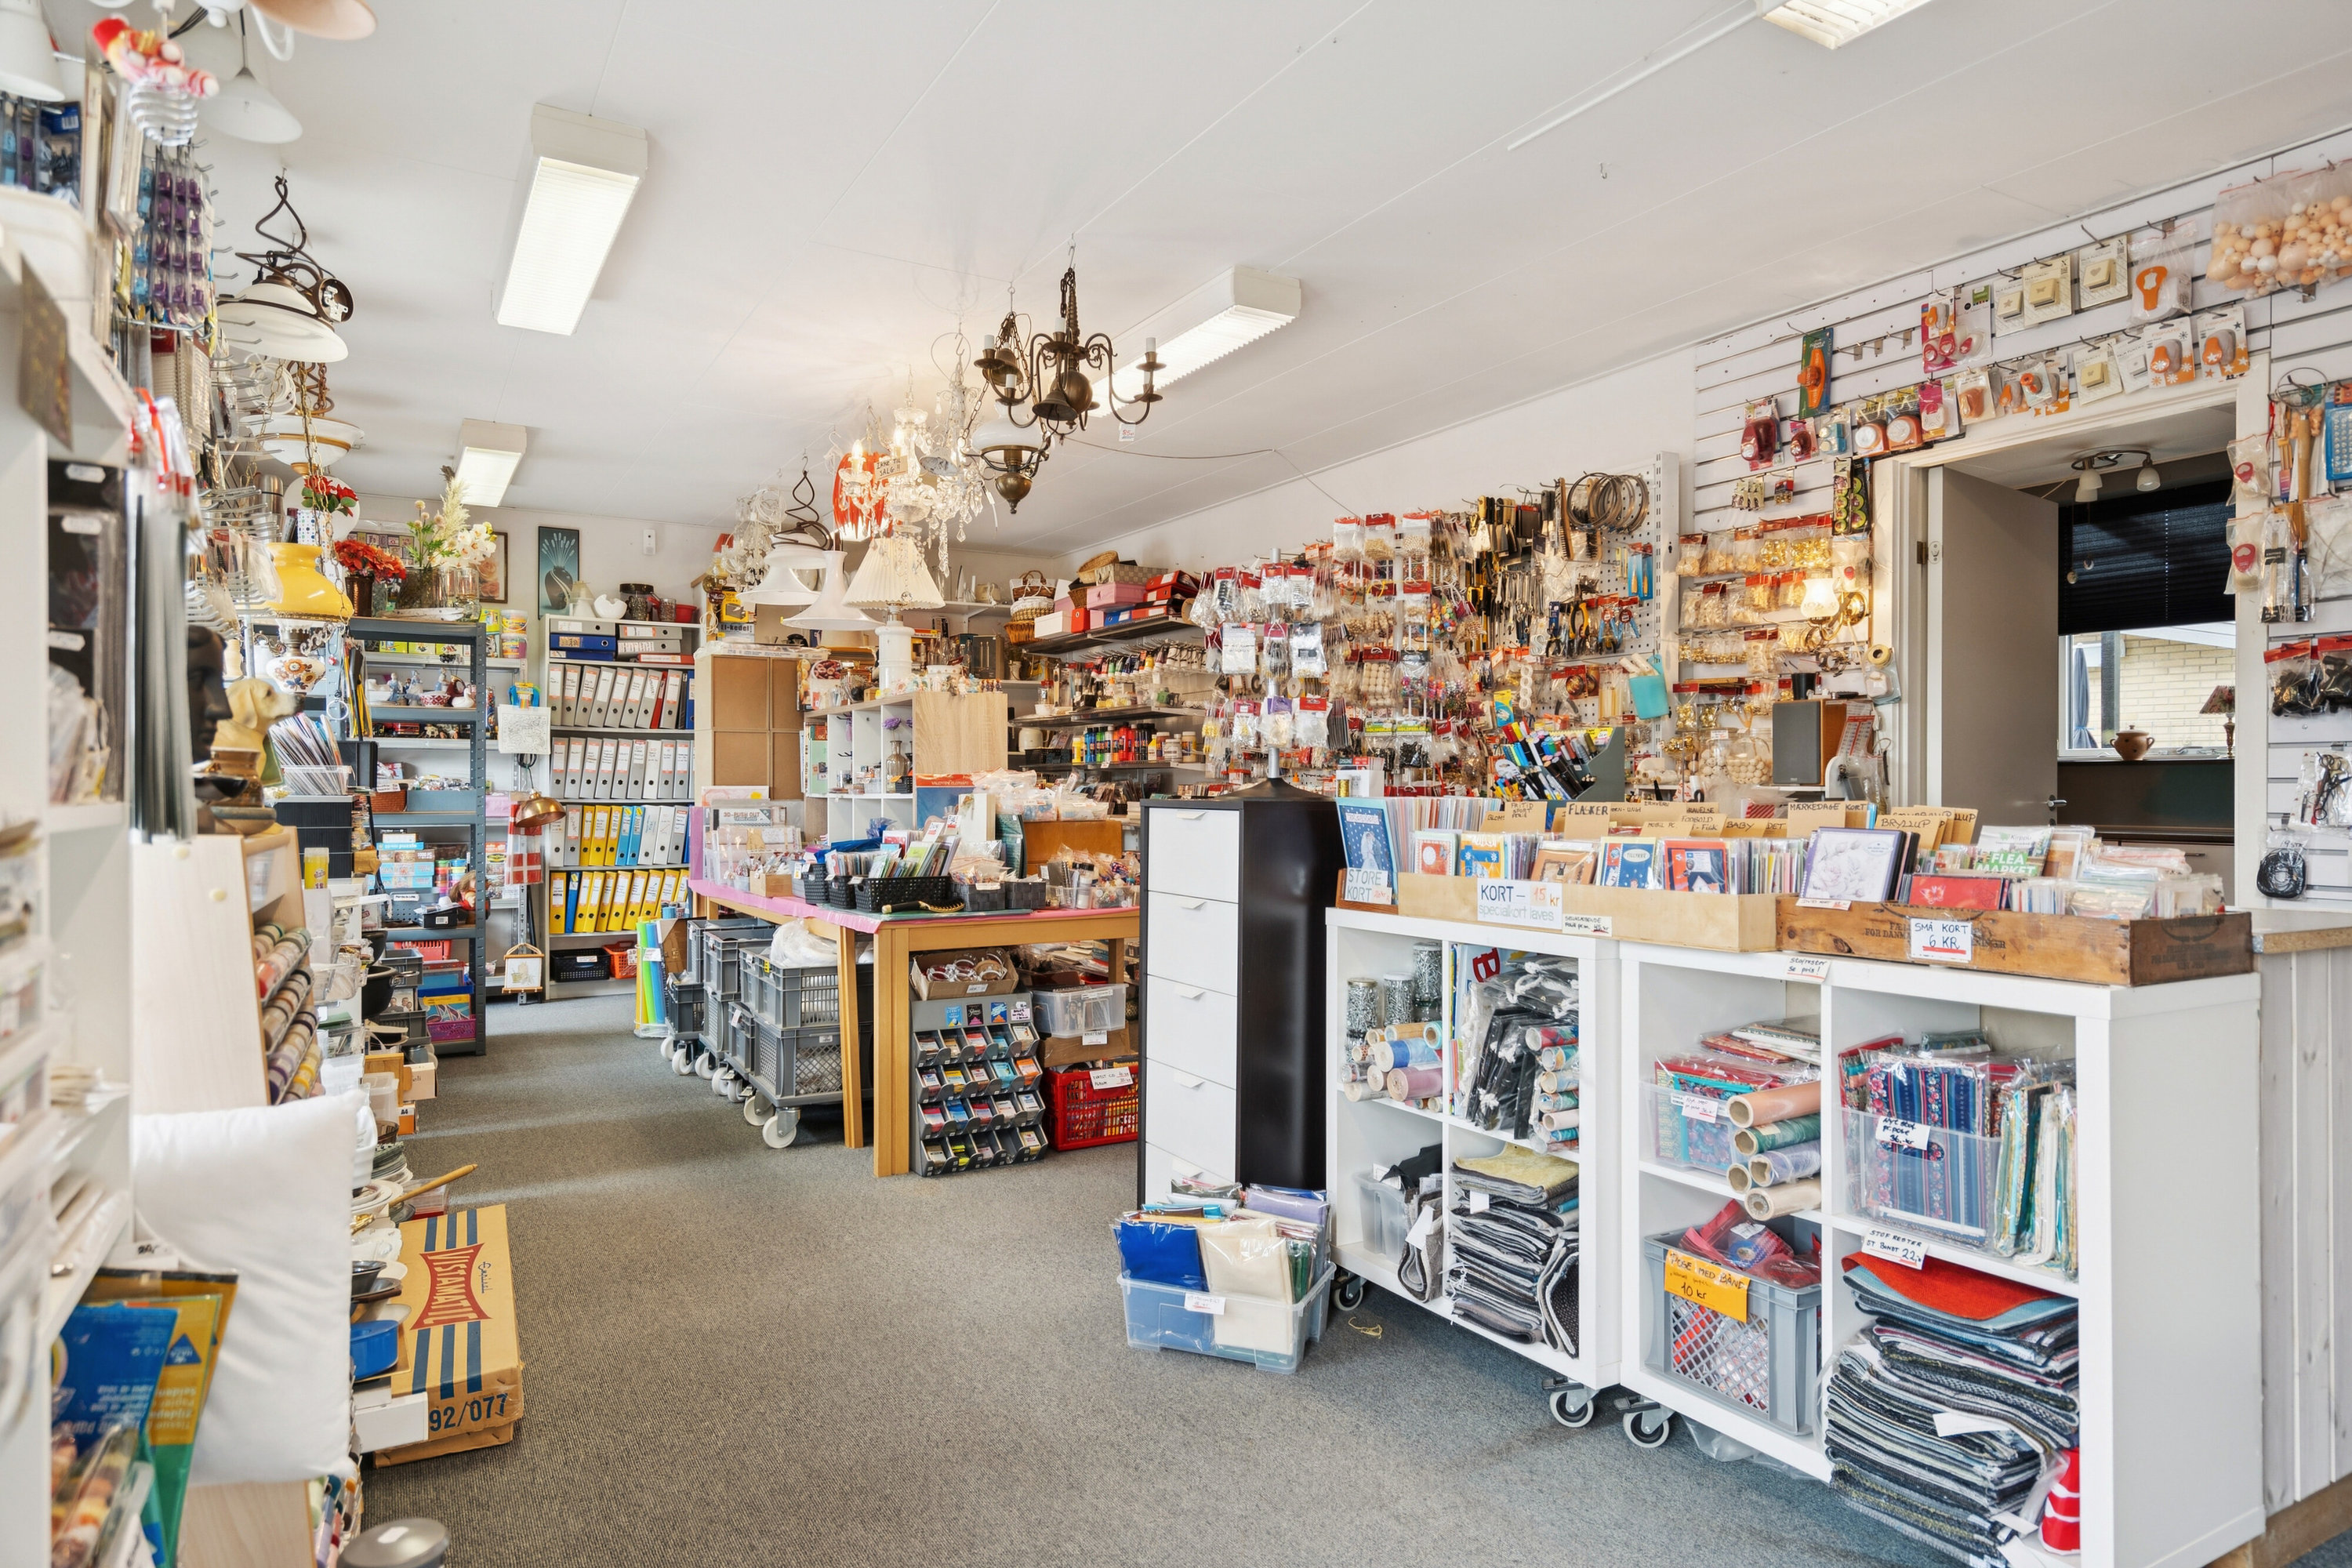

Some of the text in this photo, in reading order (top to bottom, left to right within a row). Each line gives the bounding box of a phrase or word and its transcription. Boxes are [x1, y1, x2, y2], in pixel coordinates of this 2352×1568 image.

[1568, 803, 1609, 816] FLASKER
[1790, 802, 1841, 811] MÆRKEDAGE
[1726, 821, 1754, 832] BABY
[1881, 818, 1931, 829] BRYLLUP
[1991, 852, 2026, 865] FLEA
[1348, 869, 1383, 886] STORE
[1346, 885, 1373, 902] KORT
[1480, 884, 1515, 902] KORT
[1533, 887, 1548, 902] 15
[1549, 894, 1560, 907] kr
[1529, 903, 1555, 922] laves
[1915, 921, 1969, 934] SMÅ KORT
[1929, 936, 1961, 950] 6 KR
[1869, 1229, 1891, 1239] STOF
[1670, 1251, 1693, 1271] POSE
[1698, 1267, 1716, 1279] MED
[1719, 1272, 1745, 1290] BÅND
[423, 1249, 479, 1325] VISTAMATIC
[1681, 1282, 1708, 1300] 10 kr
[428, 1392, 509, 1433] 92/077
